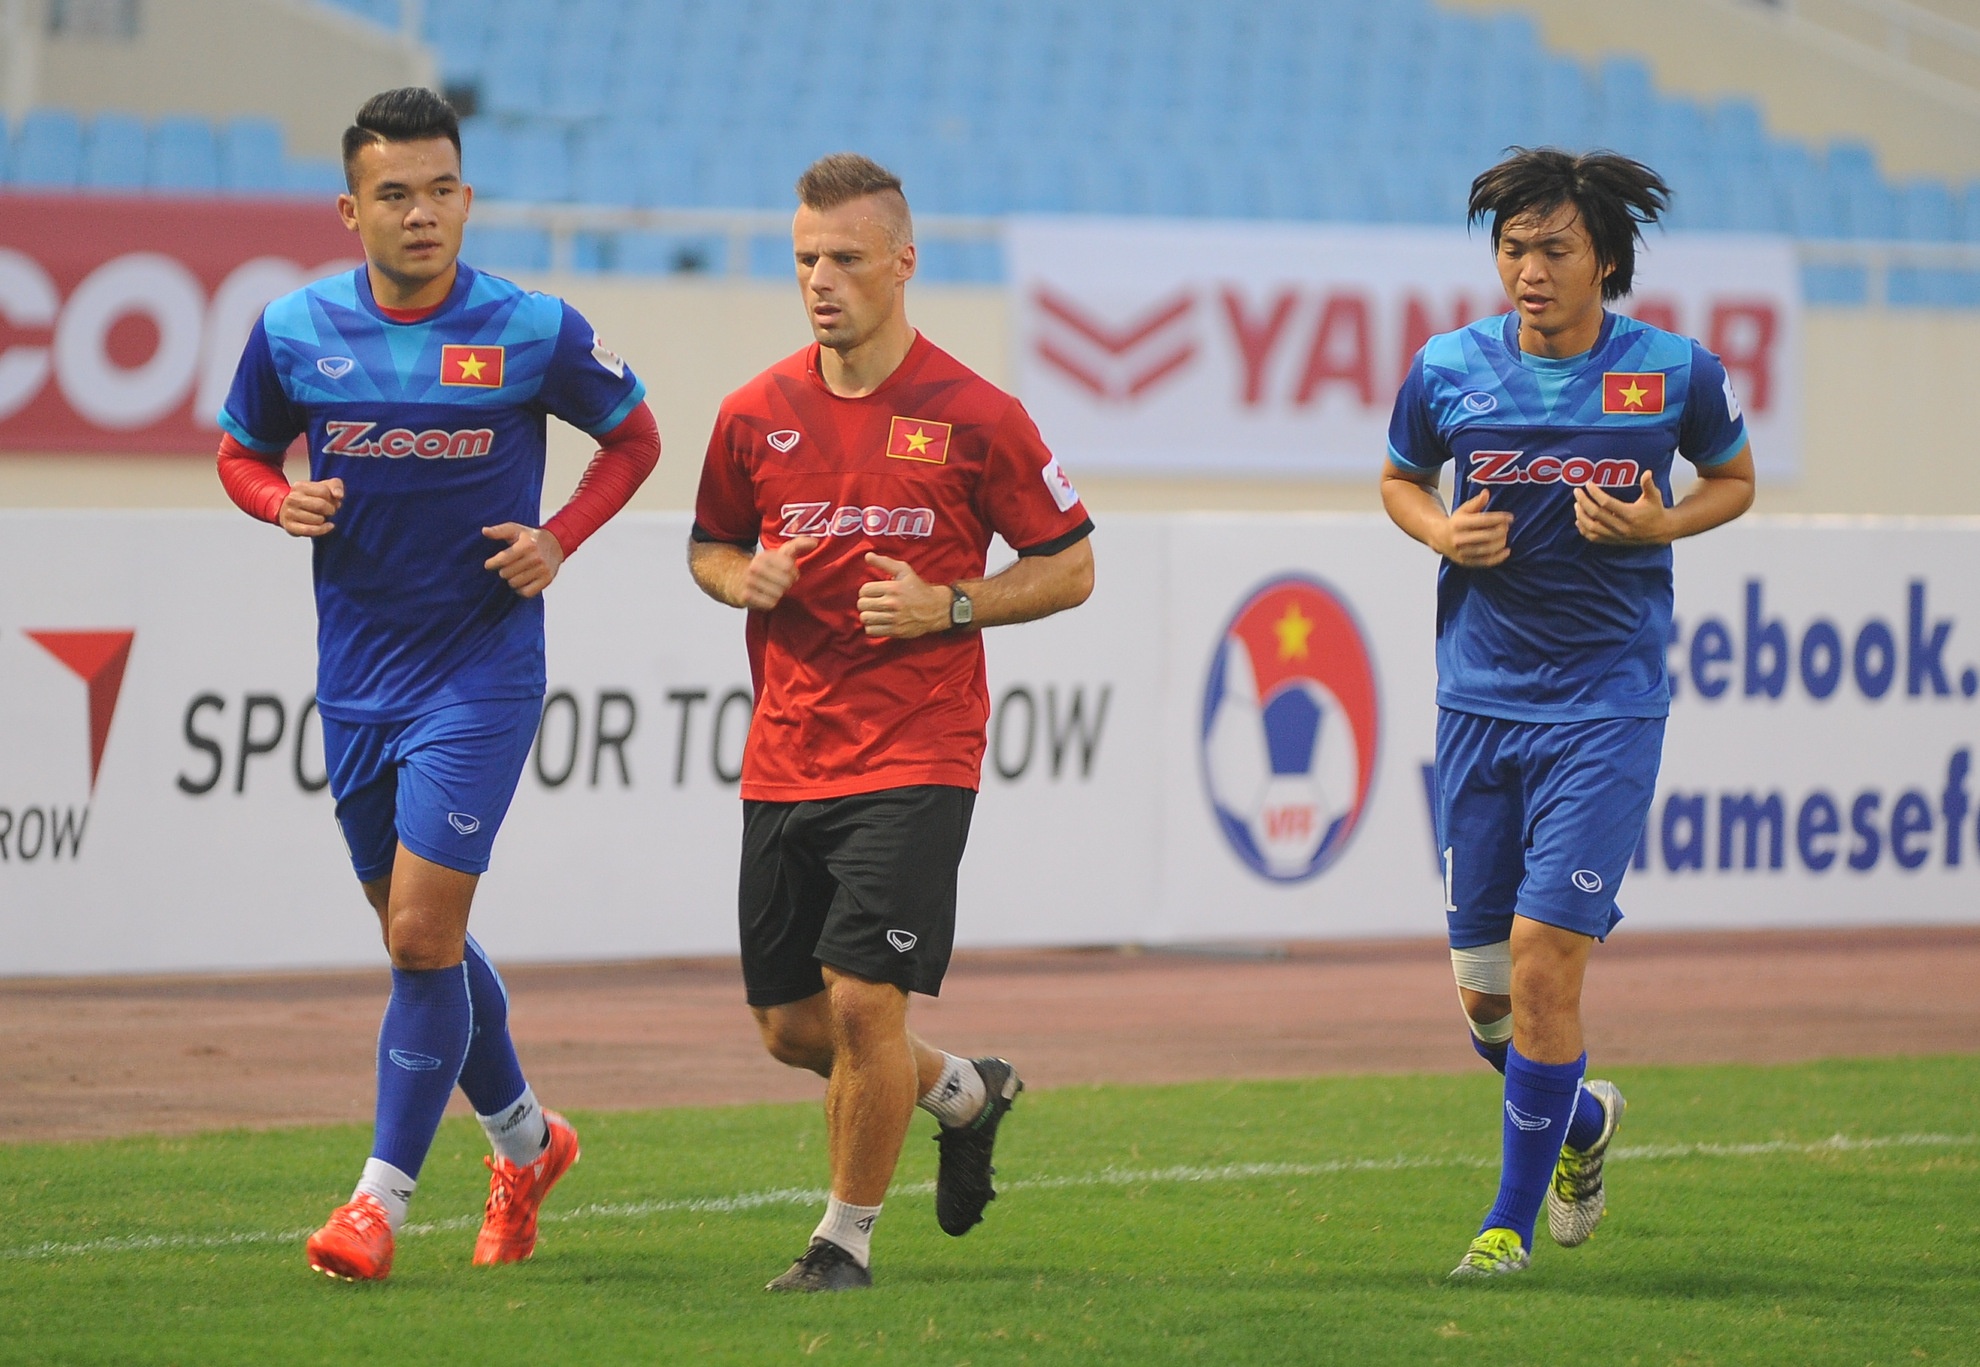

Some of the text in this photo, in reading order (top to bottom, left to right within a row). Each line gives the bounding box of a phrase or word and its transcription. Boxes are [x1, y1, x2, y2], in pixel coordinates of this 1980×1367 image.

[1221, 284, 1777, 417] YAR
[322, 420, 494, 459] Z.com
[1467, 450, 1639, 487] Z.com
[779, 501, 935, 538] Z.com
[1667, 576, 1978, 700] ebook.
[176, 693, 329, 795] SPO
[536, 689, 633, 788] OR
